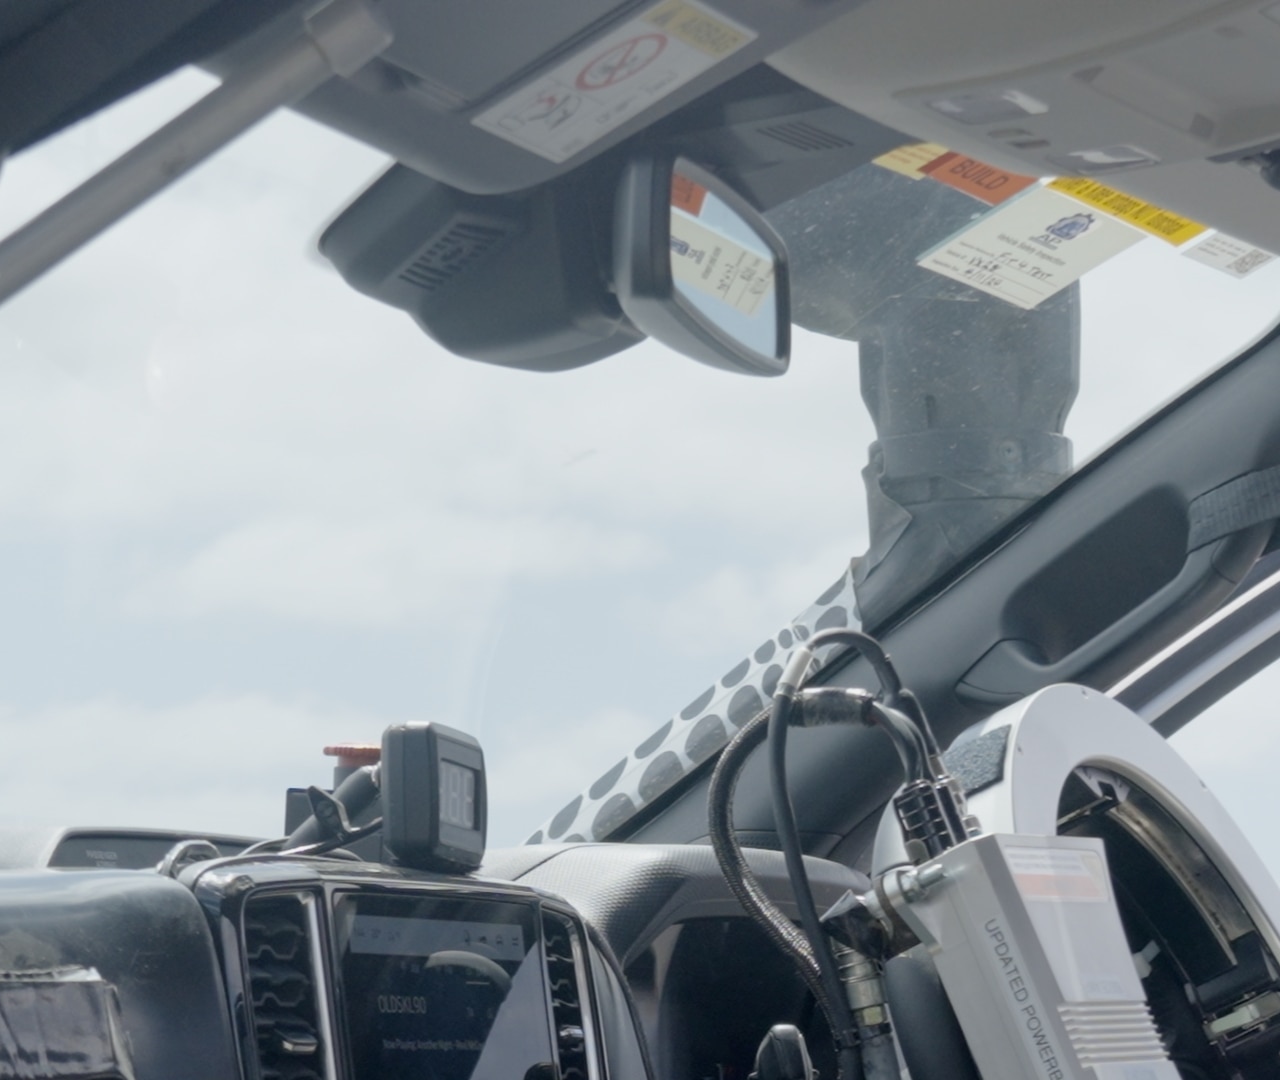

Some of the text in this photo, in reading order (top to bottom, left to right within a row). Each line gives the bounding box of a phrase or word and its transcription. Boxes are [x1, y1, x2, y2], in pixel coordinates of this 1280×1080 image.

[949, 157, 1009, 191] BUILD
[984, 918, 1029, 1003] UPDATED
[378, 994, 428, 1014] OLDSKL90
